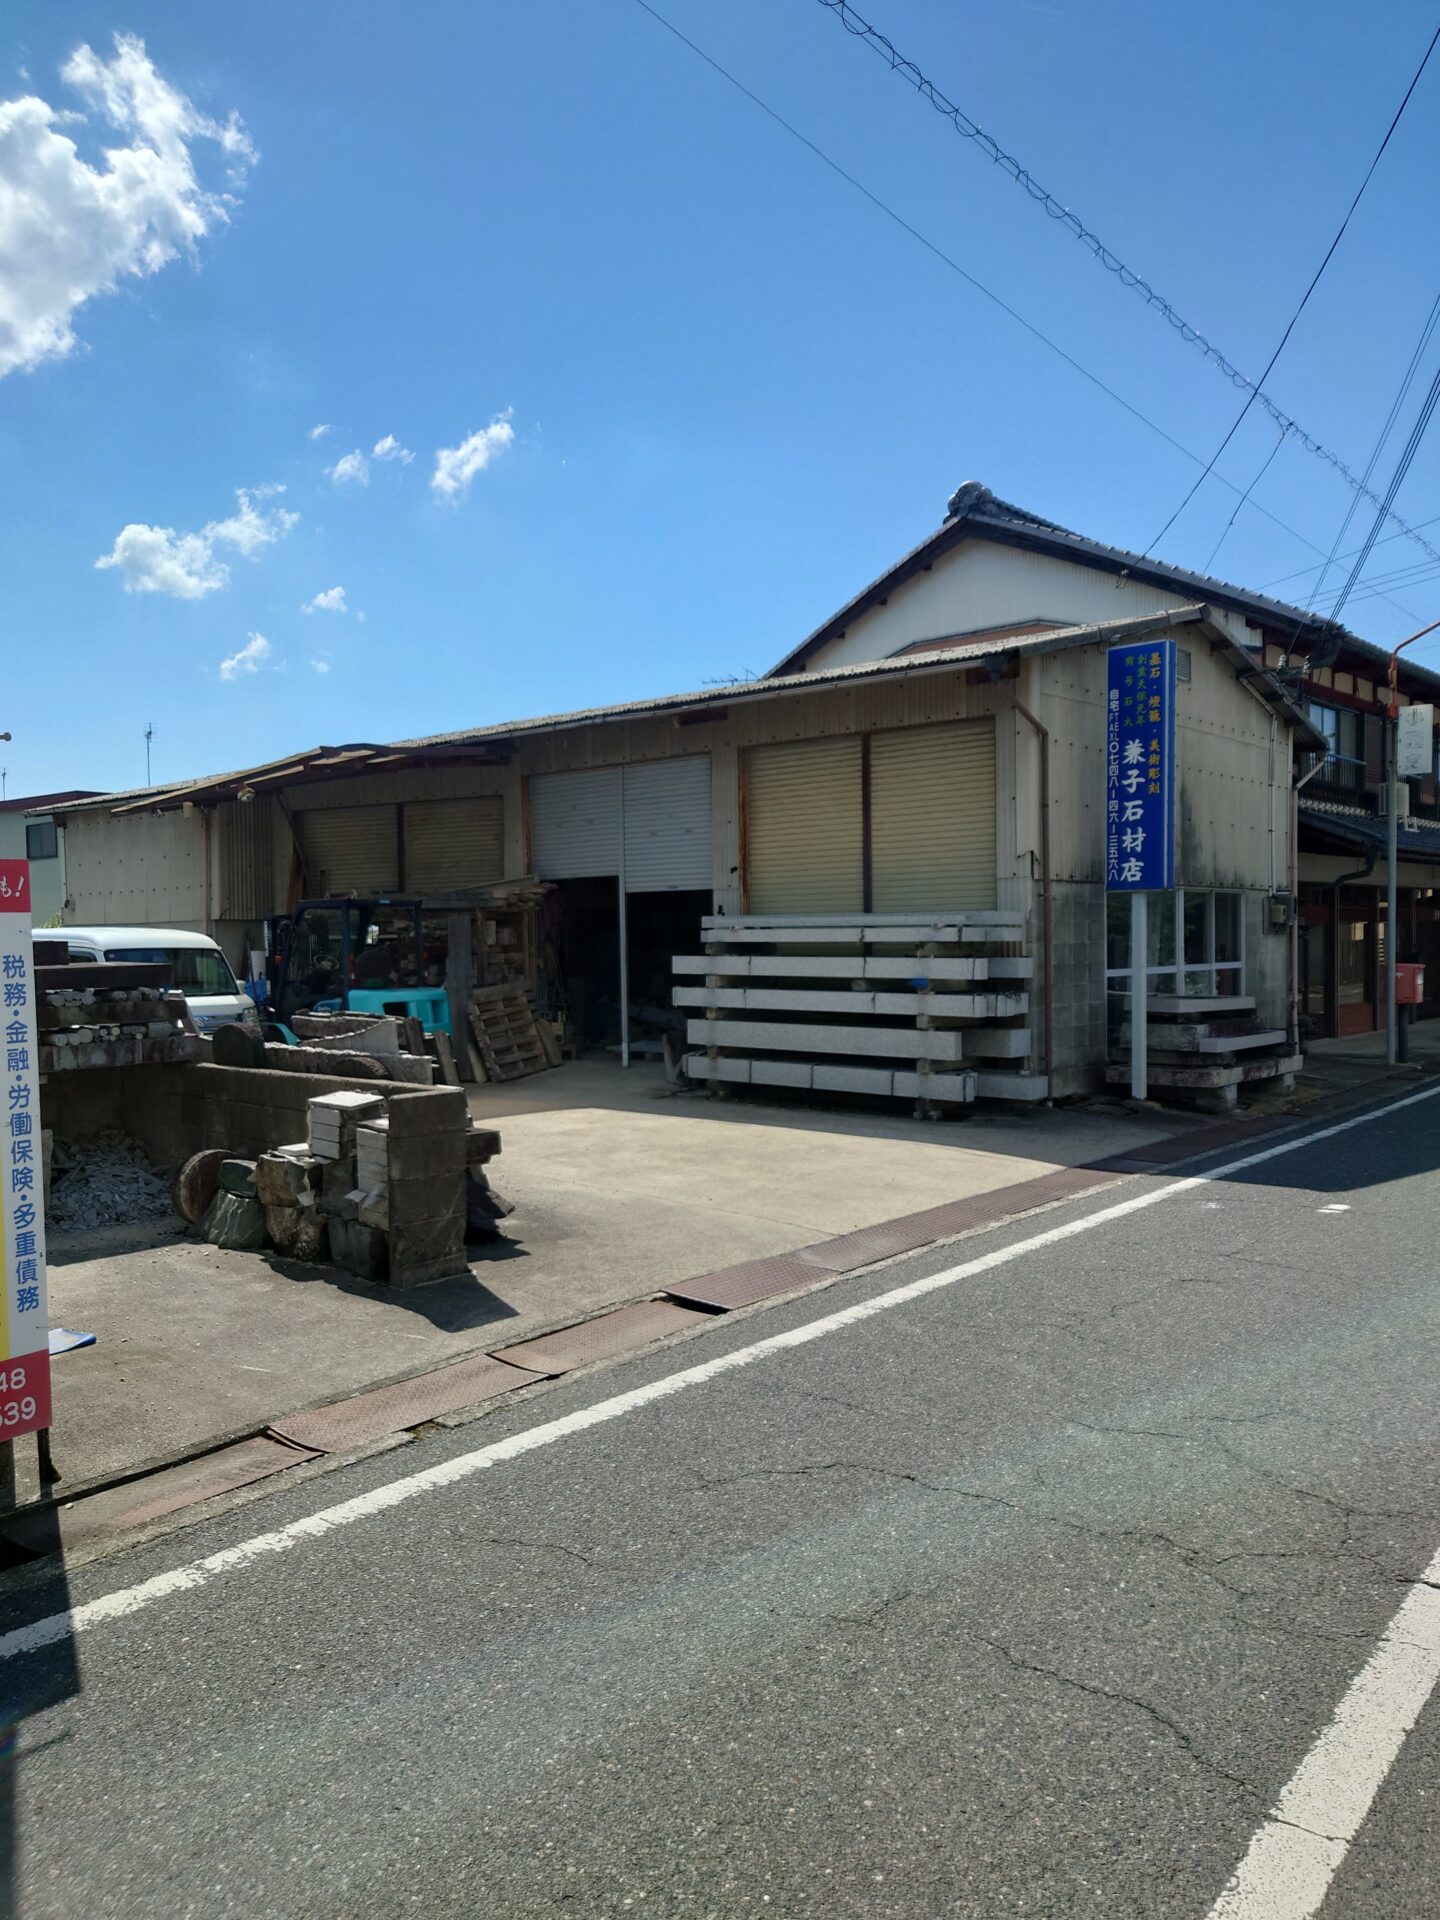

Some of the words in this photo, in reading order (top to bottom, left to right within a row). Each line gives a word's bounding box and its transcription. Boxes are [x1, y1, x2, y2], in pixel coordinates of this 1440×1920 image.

[1120, 739, 1147, 882] 兼子石材店
[2, 954, 39, 1314] 税務・金融・労働保険・多重債務
[0, 1396, 36, 1427] 39
